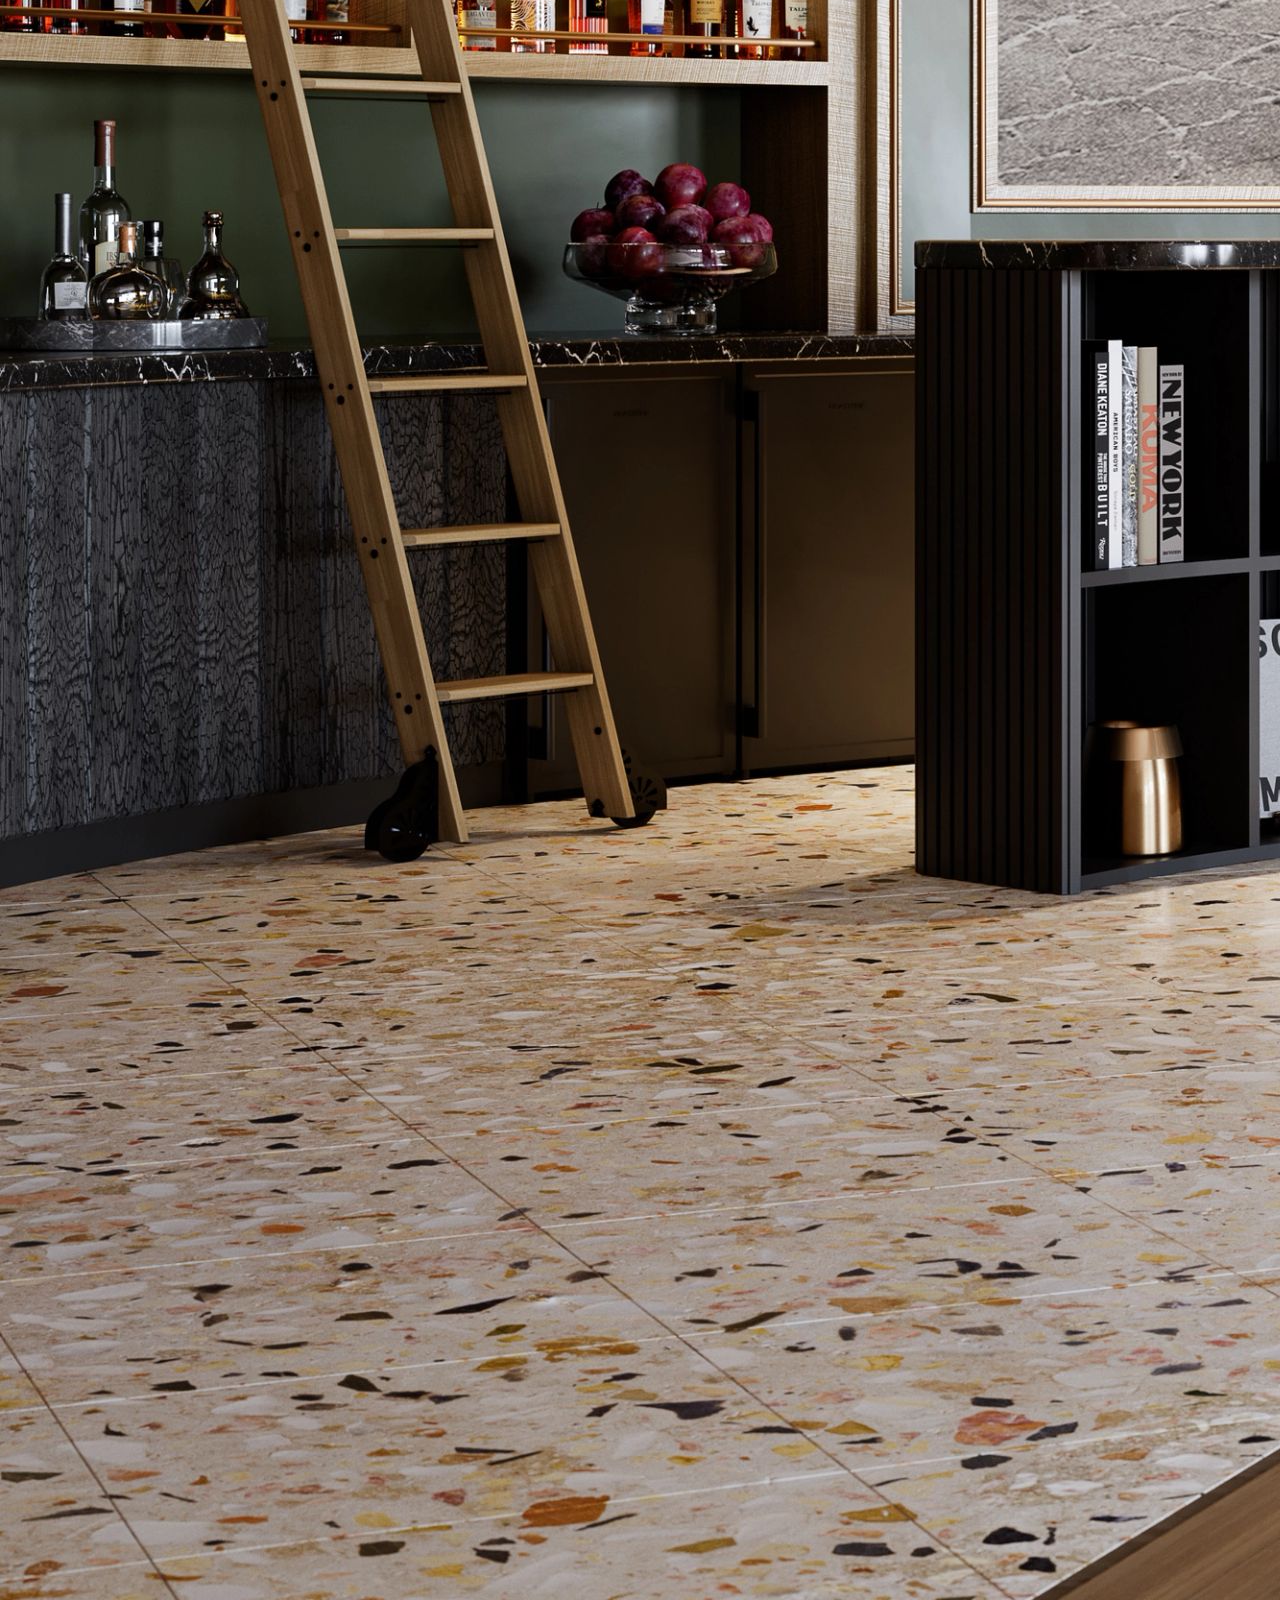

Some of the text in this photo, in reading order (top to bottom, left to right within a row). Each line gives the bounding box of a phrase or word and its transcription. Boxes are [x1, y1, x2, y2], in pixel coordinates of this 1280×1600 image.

[1097, 363, 1108, 436] DIANE KEATON
[1162, 379, 1182, 446] NEW
[1141, 404, 1157, 513] KUMA
[1097, 484, 1108, 527] BUILT
[1162, 450, 1182, 541] YORK
